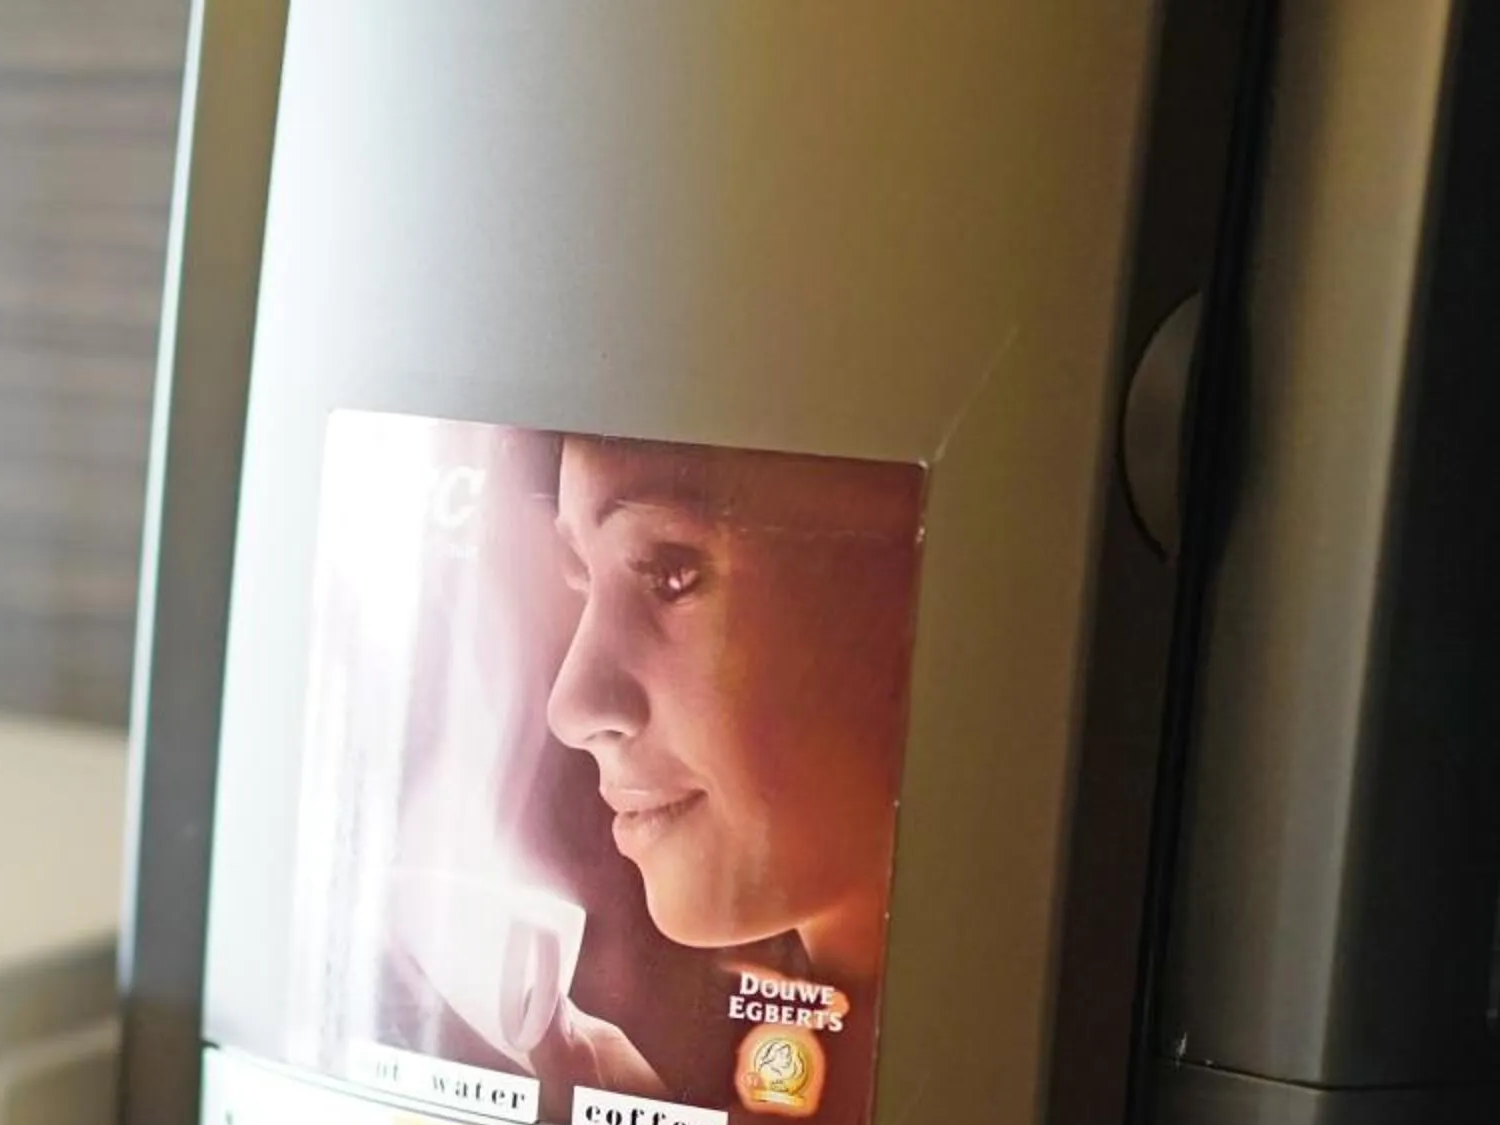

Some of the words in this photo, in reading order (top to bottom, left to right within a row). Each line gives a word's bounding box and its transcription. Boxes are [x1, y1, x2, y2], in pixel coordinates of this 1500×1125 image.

[739, 971, 836, 1005] DOUWE
[728, 996, 844, 1032] EGBERTS
[431, 1073, 526, 1110] water
